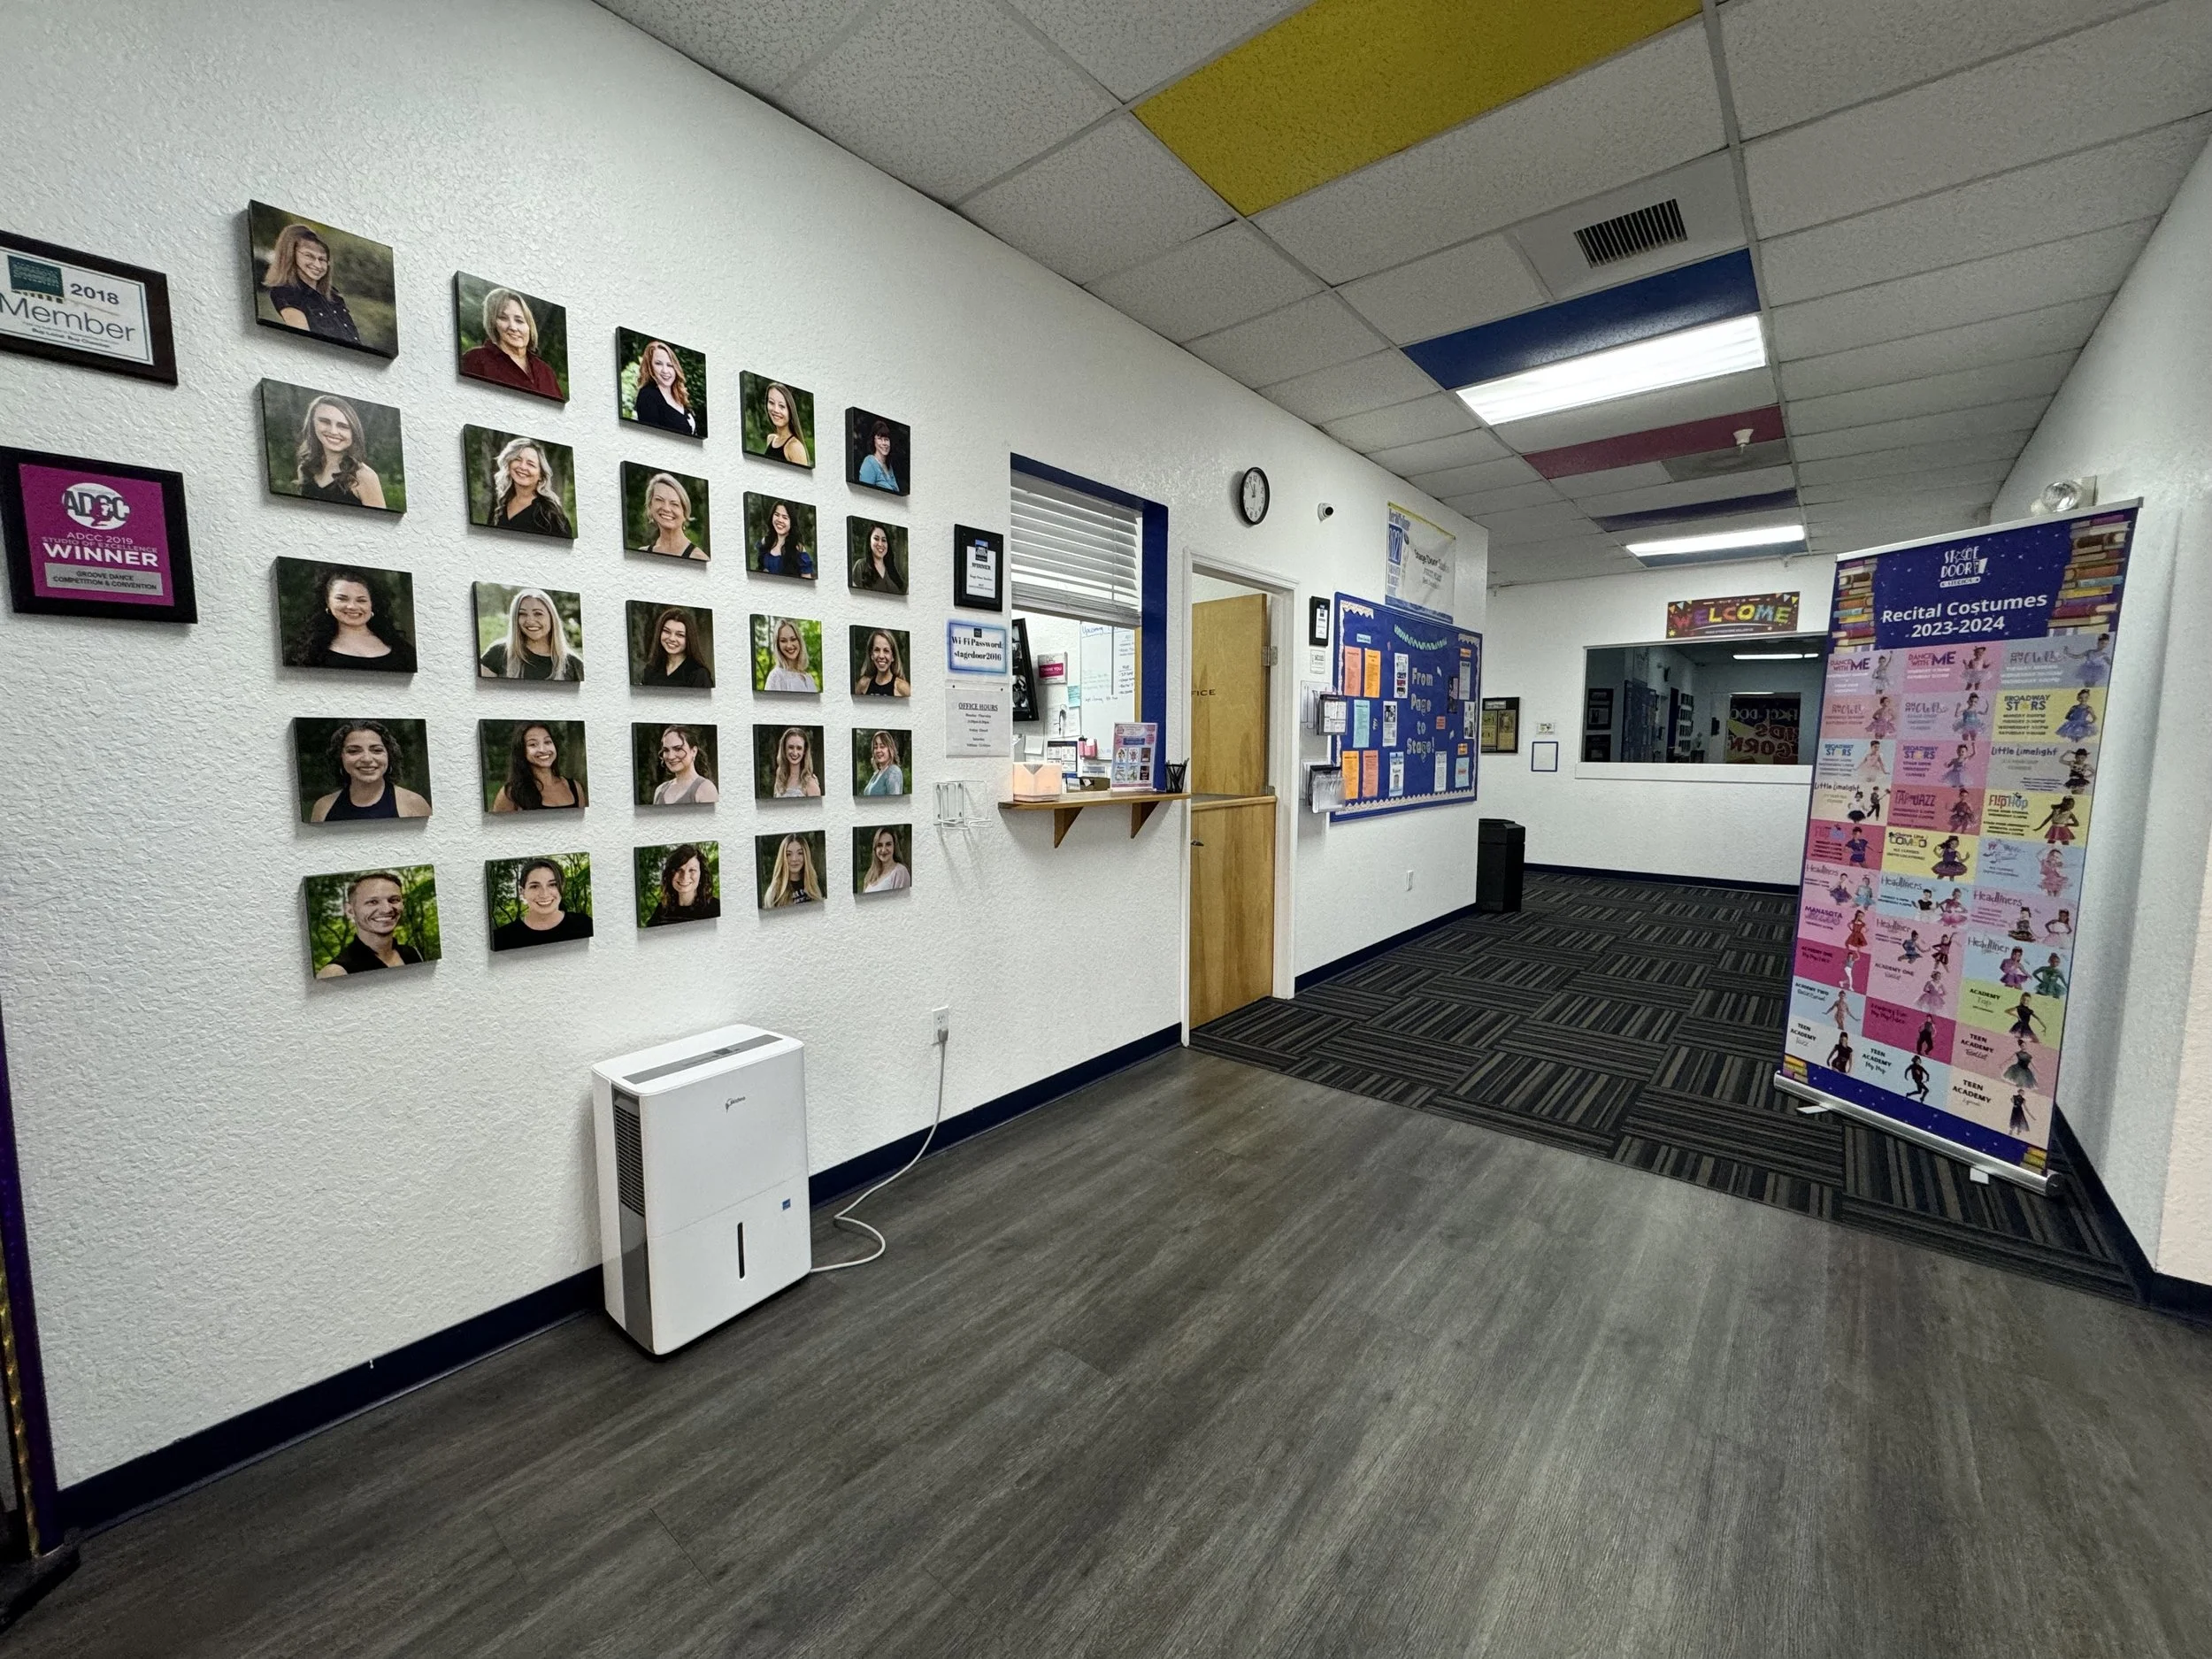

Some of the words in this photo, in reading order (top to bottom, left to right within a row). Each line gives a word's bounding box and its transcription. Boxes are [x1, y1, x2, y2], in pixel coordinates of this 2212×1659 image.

[70, 283, 119, 305] 2018
[0, 293, 135, 342] Member
[42, 536, 80, 546] STUDIO
[98, 541, 158, 554] EXCELLENCE
[66, 531, 104, 541] ADCC
[105, 534, 134, 545] 2019
[42, 542, 158, 567] WINNER
[76, 571, 108, 580] GROOVE
[1940, 562, 1972, 578] DOOR
[53, 576, 104, 587] COMPETITION
[112, 580, 157, 590] CONVENTION
[1672, 603, 1792, 628] WELCOME
[1881, 605, 1942, 624] Recital
[1946, 593, 2048, 618] Costumes
[1911, 616, 2005, 639] 2023-2024
[1908, 652, 1932, 661] DANCE
[1932, 651, 1956, 665] ME
[1850, 657, 1871, 671] ME
[1411, 667, 1433, 687] From
[1410, 693, 1432, 716] Page
[2004, 694, 2050, 703] BROADWAY
[958, 702, 979, 710] OFFICE
[1417, 720, 1426, 735] to
[1406, 736, 1435, 763] Stage!
[1991, 747, 2014, 756] Little
[2016, 747, 2058, 756] Limelight
[1881, 875, 1922, 891] Headliners
[1973, 889, 2023, 907] Headliners
[1804, 905, 1843, 918] MANASOTA
[1968, 935, 2010, 953] Headliner
[1874, 963, 1901, 973] ACADEMY
[1794, 982, 1816, 992] ACADEMY
[1970, 988, 2001, 1000] ACADEMY
[1798, 1023, 1811, 1032] TEEN
[1790, 1029, 1816, 1041] ACADEMY
[1970, 1033, 1987, 1043] TEEN
[1870, 1048, 1886, 1057] TEEN
[1961, 1039, 1994, 1053] ACADEMY
[1862, 1053, 1892, 1067] ACADEMY
[1962, 1079, 1984, 1091] TEEN
[1952, 1085, 1992, 1104] ACADEMY
